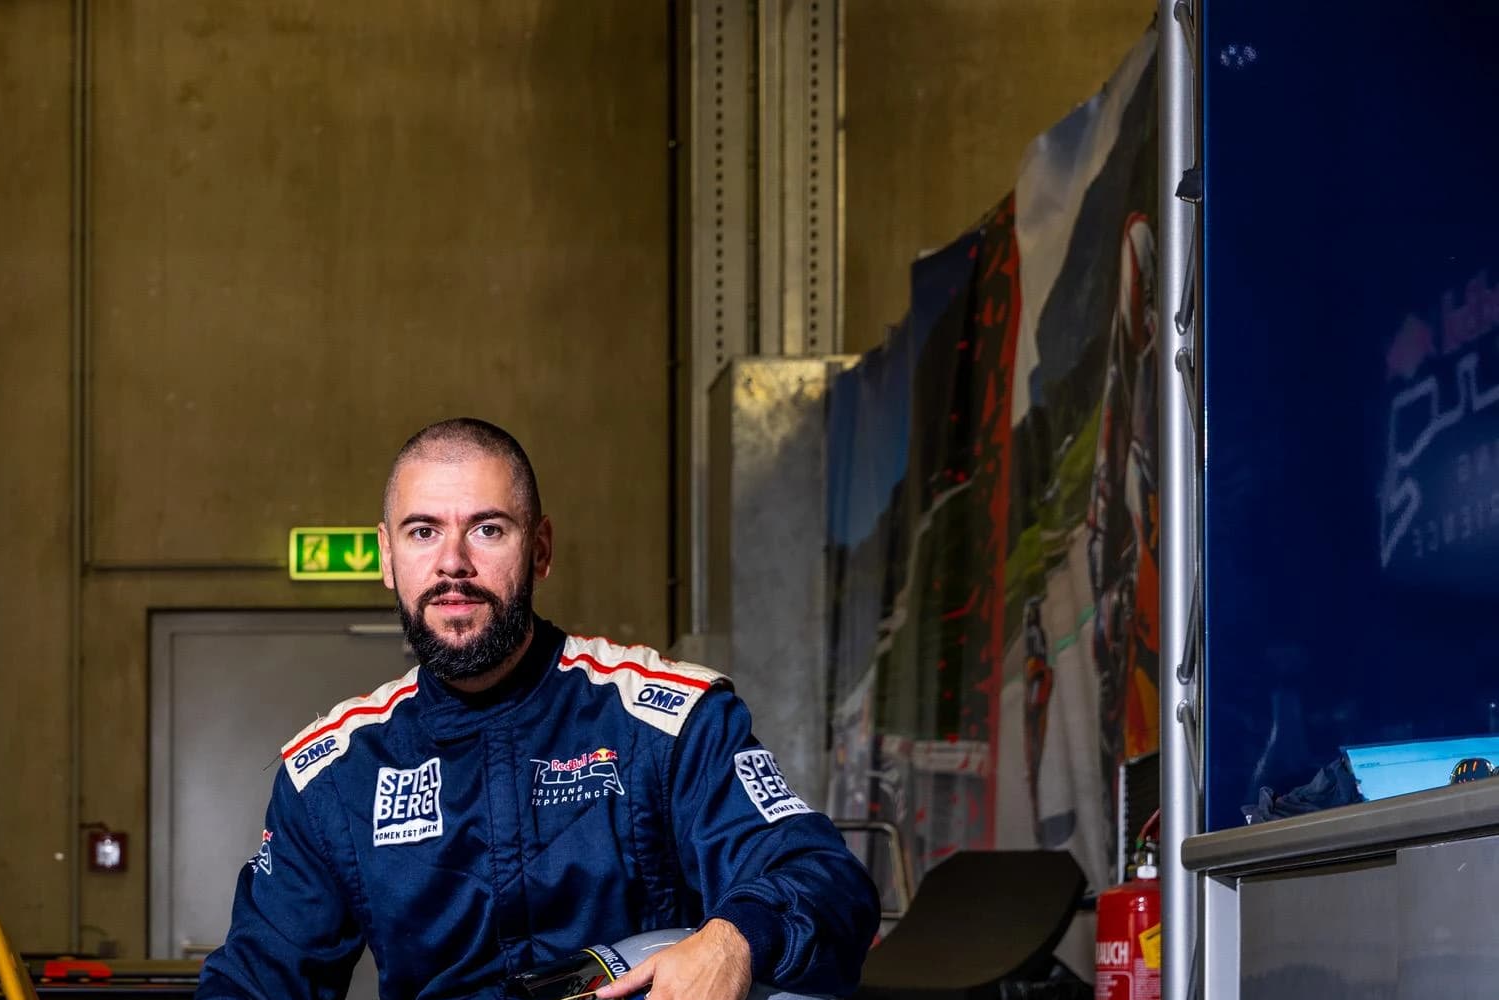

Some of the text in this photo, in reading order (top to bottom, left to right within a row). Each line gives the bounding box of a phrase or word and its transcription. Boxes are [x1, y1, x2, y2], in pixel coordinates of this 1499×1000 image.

[638, 687, 686, 711] OMP
[294, 739, 337, 769] OMP
[379, 763, 439, 796] SPIEL
[378, 788, 434, 821] BERG
[402, 828, 417, 839] EST
